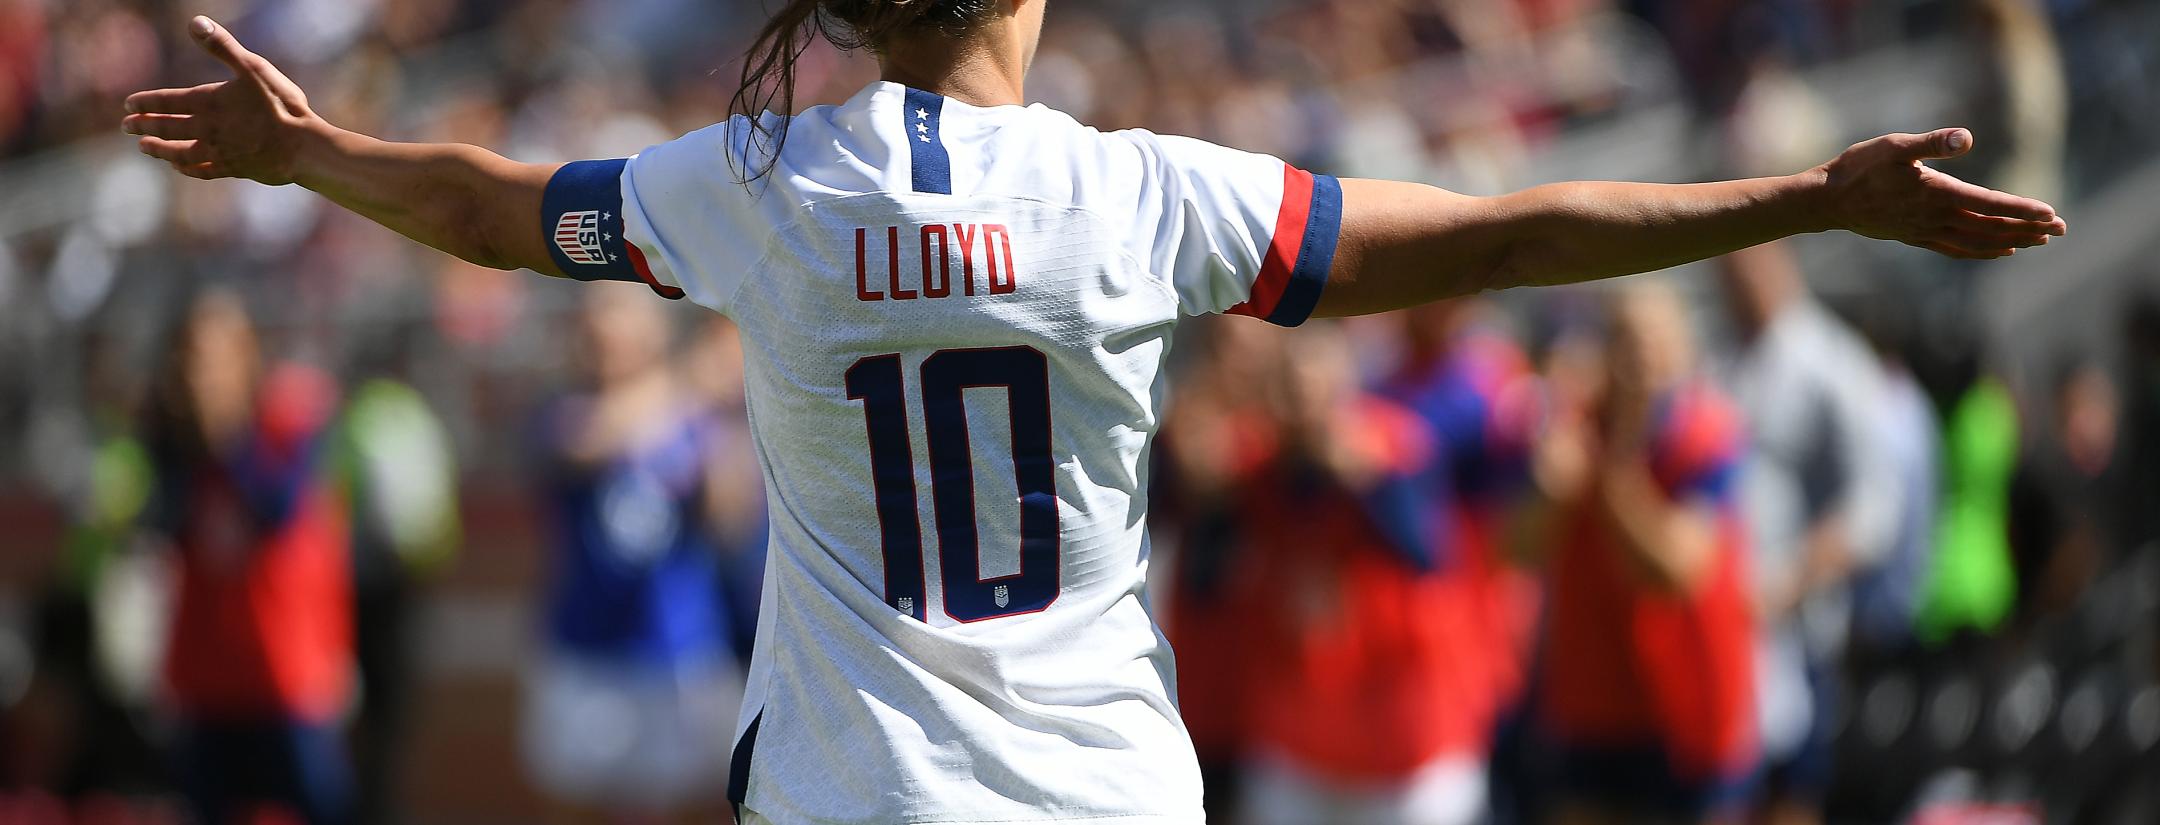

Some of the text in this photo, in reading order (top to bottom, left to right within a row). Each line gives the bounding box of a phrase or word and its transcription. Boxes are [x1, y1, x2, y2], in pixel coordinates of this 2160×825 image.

[579, 213, 605, 262] USA
[855, 223, 1016, 301] LLOYD
[844, 345, 1061, 624] 10
